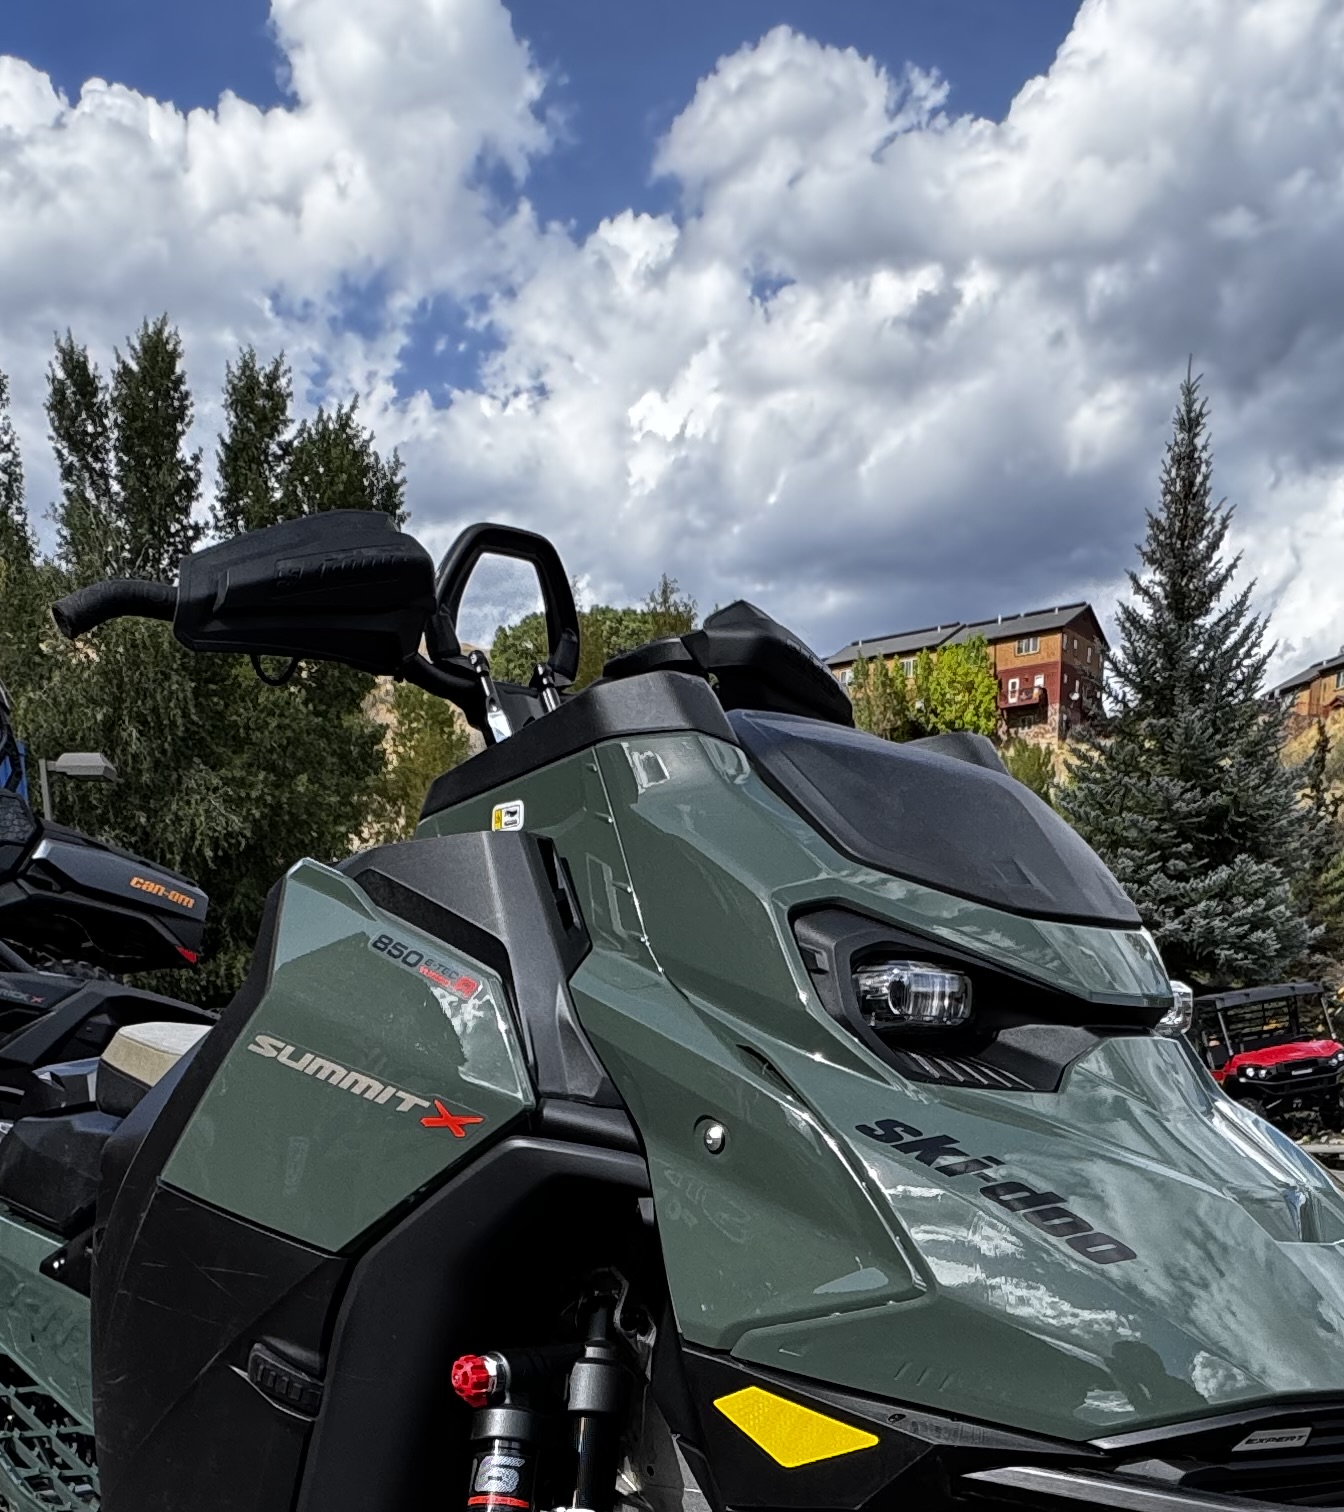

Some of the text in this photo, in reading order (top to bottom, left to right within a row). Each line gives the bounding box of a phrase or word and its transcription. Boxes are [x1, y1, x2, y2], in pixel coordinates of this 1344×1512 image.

[372, 934, 424, 967] 850
[248, 1035, 484, 1137] SUMMIT X
[855, 1119, 1137, 1264] ski-doo
